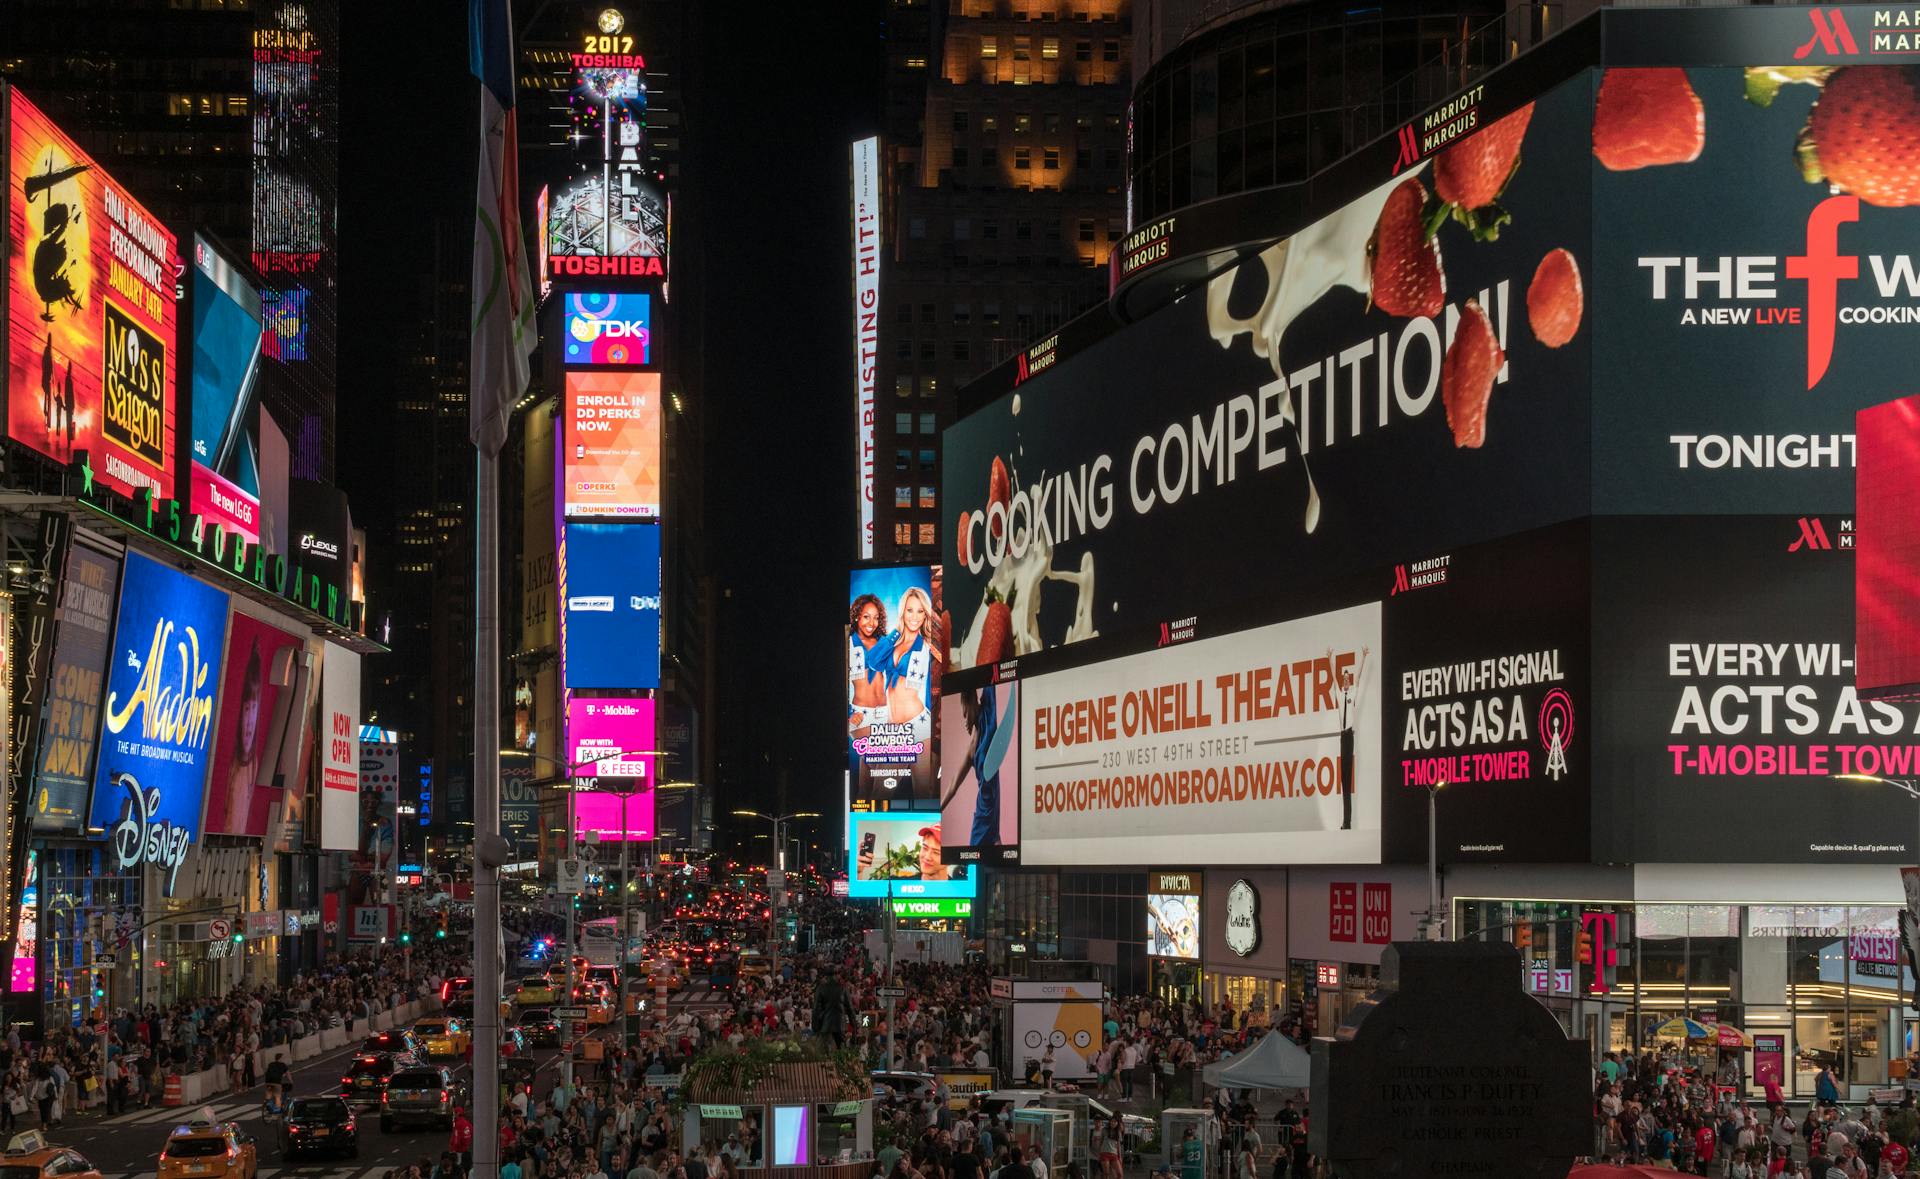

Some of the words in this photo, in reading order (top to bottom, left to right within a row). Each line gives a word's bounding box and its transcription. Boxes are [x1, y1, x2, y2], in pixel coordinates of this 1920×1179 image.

[585, 36, 633, 53] 2017
[572, 54, 644, 68] TOSHIBA
[1424, 84, 1484, 132] MARRIOTT
[1424, 111, 1476, 152] MARQUIS
[104, 186, 127, 229] FINAL
[129, 214, 167, 262] BROADWAY
[1122, 217, 1176, 255] MARRIOTT
[109, 226, 163, 292] PERFORMANCE
[550, 256, 663, 275] TOSHIBA
[1122, 241, 1168, 275] MARQUIS
[109, 260, 142, 308] JANUARY
[145, 290, 162, 324] 14TH
[1638, 256, 1777, 299] THE
[1786, 195, 1860, 391] f
[586, 320, 644, 337] TDK
[1680, 308, 1697, 325] A
[1701, 308, 1751, 324] NEW
[1756, 308, 1801, 324] LIVE
[1030, 334, 1058, 360] MARRIOTT
[1029, 351, 1055, 374] MARQUIS
[107, 369, 162, 450] Saigon
[576, 395, 628, 406] ENROLL
[632, 395, 646, 406] IN
[576, 409, 595, 418] DD
[598, 408, 640, 419] PERKS
[576, 421, 612, 431] NOW.
[105, 453, 161, 500] SAIGONBROADWAY.COM
[210, 483, 221, 504] The
[222, 494, 234, 512] new
[234, 499, 243, 518] LG
[242, 505, 252, 524] G6
[966, 455, 1113, 575] COOKING
[311, 540, 338, 553] LEXUS
[1411, 555, 1451, 574] MARRIOTT
[1411, 571, 1446, 588] MARQUIS
[1171, 616, 1197, 630] MARRIOTT
[1171, 629, 1194, 642] MARQUIS
[1669, 643, 1789, 676] EVERY
[1794, 643, 1857, 676] WI-
[56, 664, 100, 706] COME
[107, 617, 212, 749] Aladdin
[1402, 664, 1453, 700] EVERY
[1454, 657, 1496, 693] WI-FI
[1498, 649, 1564, 688] SIGNAL
[1035, 695, 1117, 749] EUGENE
[1121, 679, 1211, 738] O'NEILL
[1403, 701, 1467, 751] ACTS
[1469, 697, 1504, 746] AS
[1507, 694, 1528, 741] A
[1670, 684, 1820, 735] ACTS
[1828, 685, 1905, 735] AS
[333, 712, 351, 738] NOW
[871, 724, 912, 735] DALLAS
[117, 741, 129, 754] THE
[130, 744, 140, 756] HIT
[141, 745, 171, 760] BROADWAY
[172, 751, 194, 765] MUSICAL
[332, 738, 351, 765] OPEN
[853, 738, 923, 754] Cheerleaders
[868, 735, 914, 746] COWBOYS
[1102, 751, 1121, 768] 230
[1126, 746, 1158, 766] WEST
[1163, 740, 1194, 761] 49TH
[1199, 735, 1249, 758] STREET
[45, 737, 90, 777] AWAY
[600, 763, 608, 774] &
[612, 763, 642, 774] FEES
[1402, 754, 1471, 786] T-MOBILE
[1472, 751, 1530, 781] TOWER
[1667, 744, 1829, 776] T-MOBILE
[1160, 875, 1190, 890] INVICTA
[908, 903, 939, 913] YORK
[1366, 890, 1388, 912] UNI
[1365, 917, 1389, 938] QLO
[1848, 933, 1897, 961] FASTEST
[1381, 1083, 1457, 1101] FRANCIS
[1480, 1082, 1544, 1101] DUFFY
[1473, 1127, 1523, 1140] PRIEST
[1187, 1150, 1201, 1161] 23
